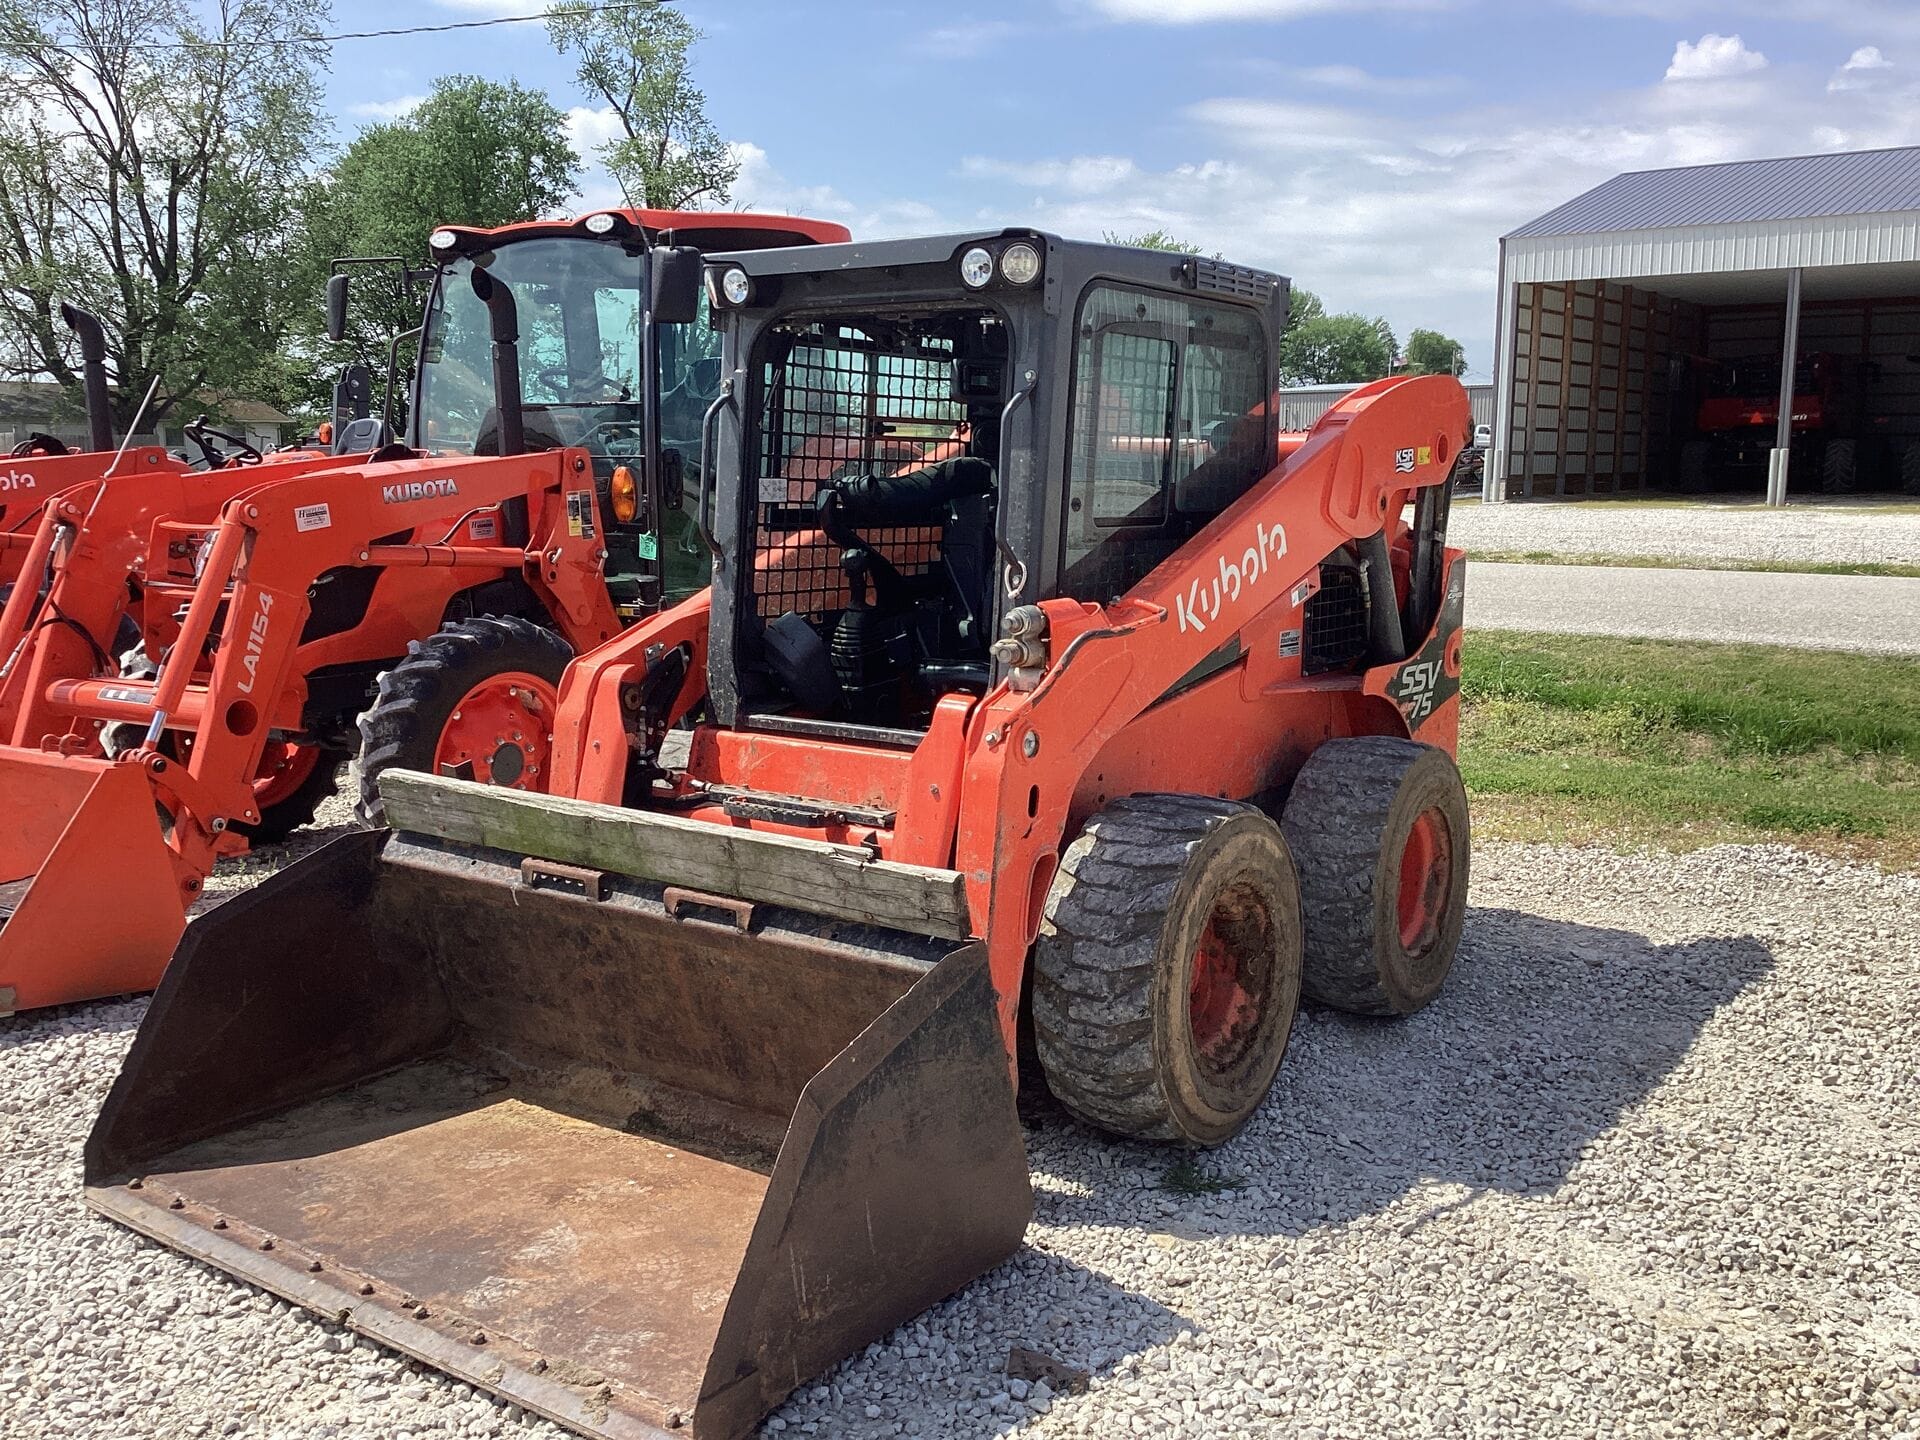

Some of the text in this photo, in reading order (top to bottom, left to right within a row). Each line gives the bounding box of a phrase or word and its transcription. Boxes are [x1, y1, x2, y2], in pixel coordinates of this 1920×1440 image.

[1395, 448, 1414, 464] KSR
[382, 478, 458, 504] KUBOTA
[1175, 523, 1287, 634] Kubota
[237, 591, 273, 694] LA1154
[1398, 659, 1443, 697] SSV
[1411, 690, 1434, 719] 75
